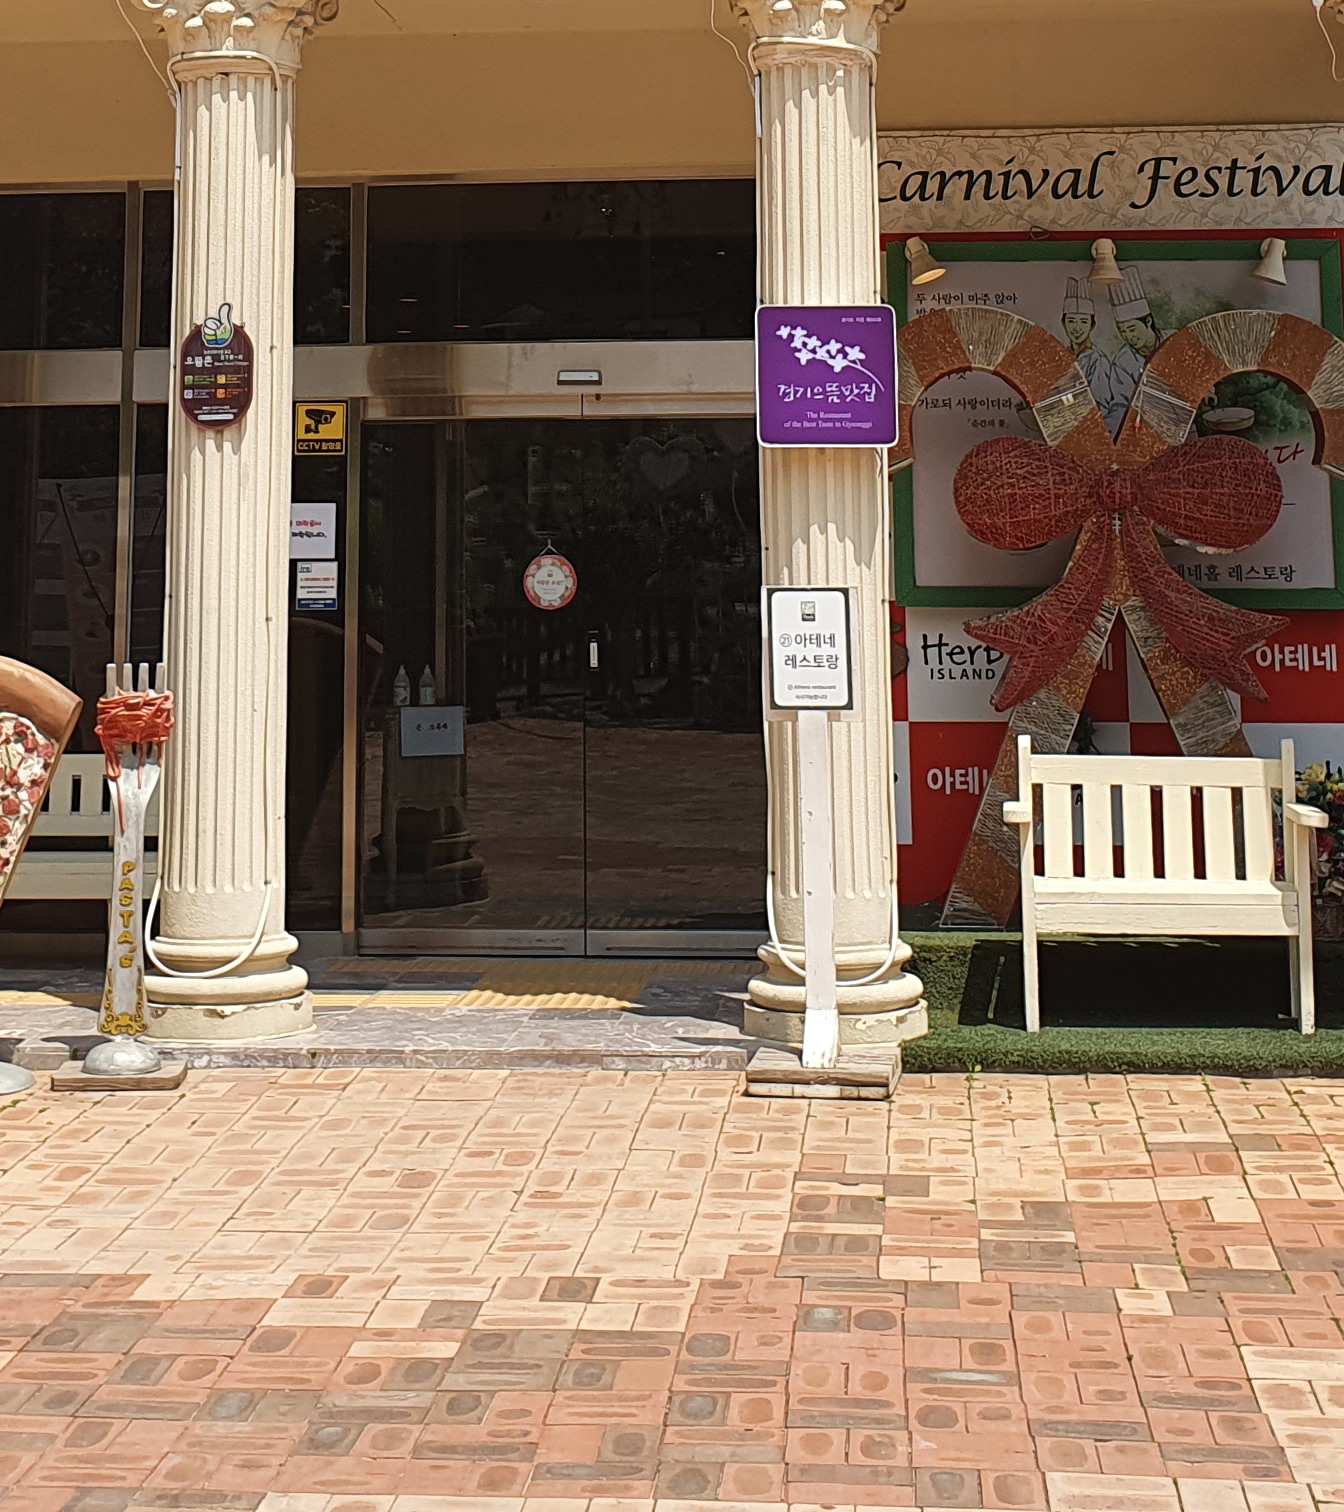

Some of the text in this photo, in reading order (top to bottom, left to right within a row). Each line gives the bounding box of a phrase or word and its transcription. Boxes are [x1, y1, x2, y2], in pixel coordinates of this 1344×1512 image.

[878, 150, 1117, 202] Carnival
[915, 293, 927, 305] 두
[297, 441, 321, 450] CCTV
[1228, 564, 1296, 582] 레스토랑
[794, 632, 836, 648] 아테네
[784, 653, 840, 670] 레스토랑
[1256, 643, 1338, 672] 아테네
[930, 667, 996, 681] ISLAND
[926, 766, 988, 795] 아테
